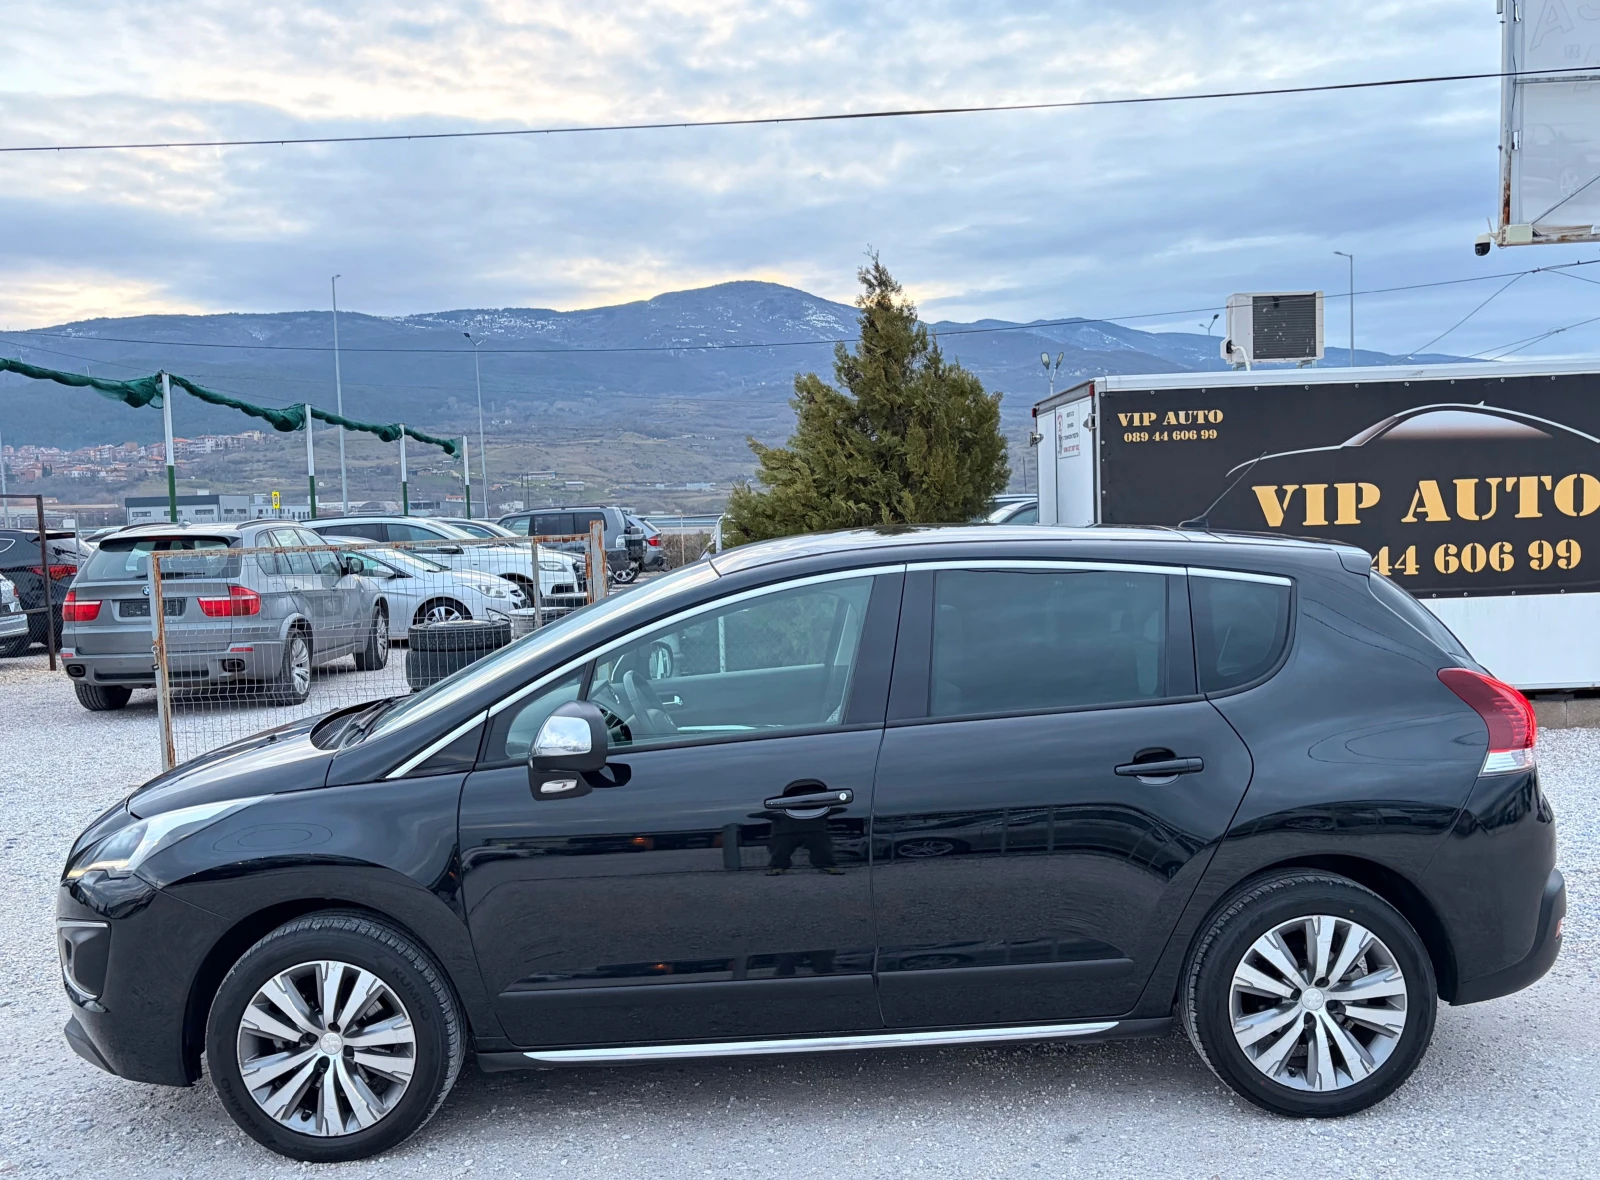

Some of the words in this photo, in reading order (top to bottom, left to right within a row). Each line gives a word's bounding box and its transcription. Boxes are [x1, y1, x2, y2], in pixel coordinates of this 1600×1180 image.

[1117, 412, 1157, 427] VIP
[1162, 409, 1224, 425] AUTO
[1123, 432, 1149, 443] 089
[1152, 431, 1169, 442] 44
[1172, 429, 1198, 441] 606
[1200, 429, 1218, 440] 99
[1251, 482, 1381, 528] VIP
[1400, 473, 1600, 523] AUTO
[1370, 545, 1420, 576] 44
[1433, 541, 1515, 574] 606
[1527, 538, 1582, 571] 99
[390, 966, 432, 1022] KUMHO
